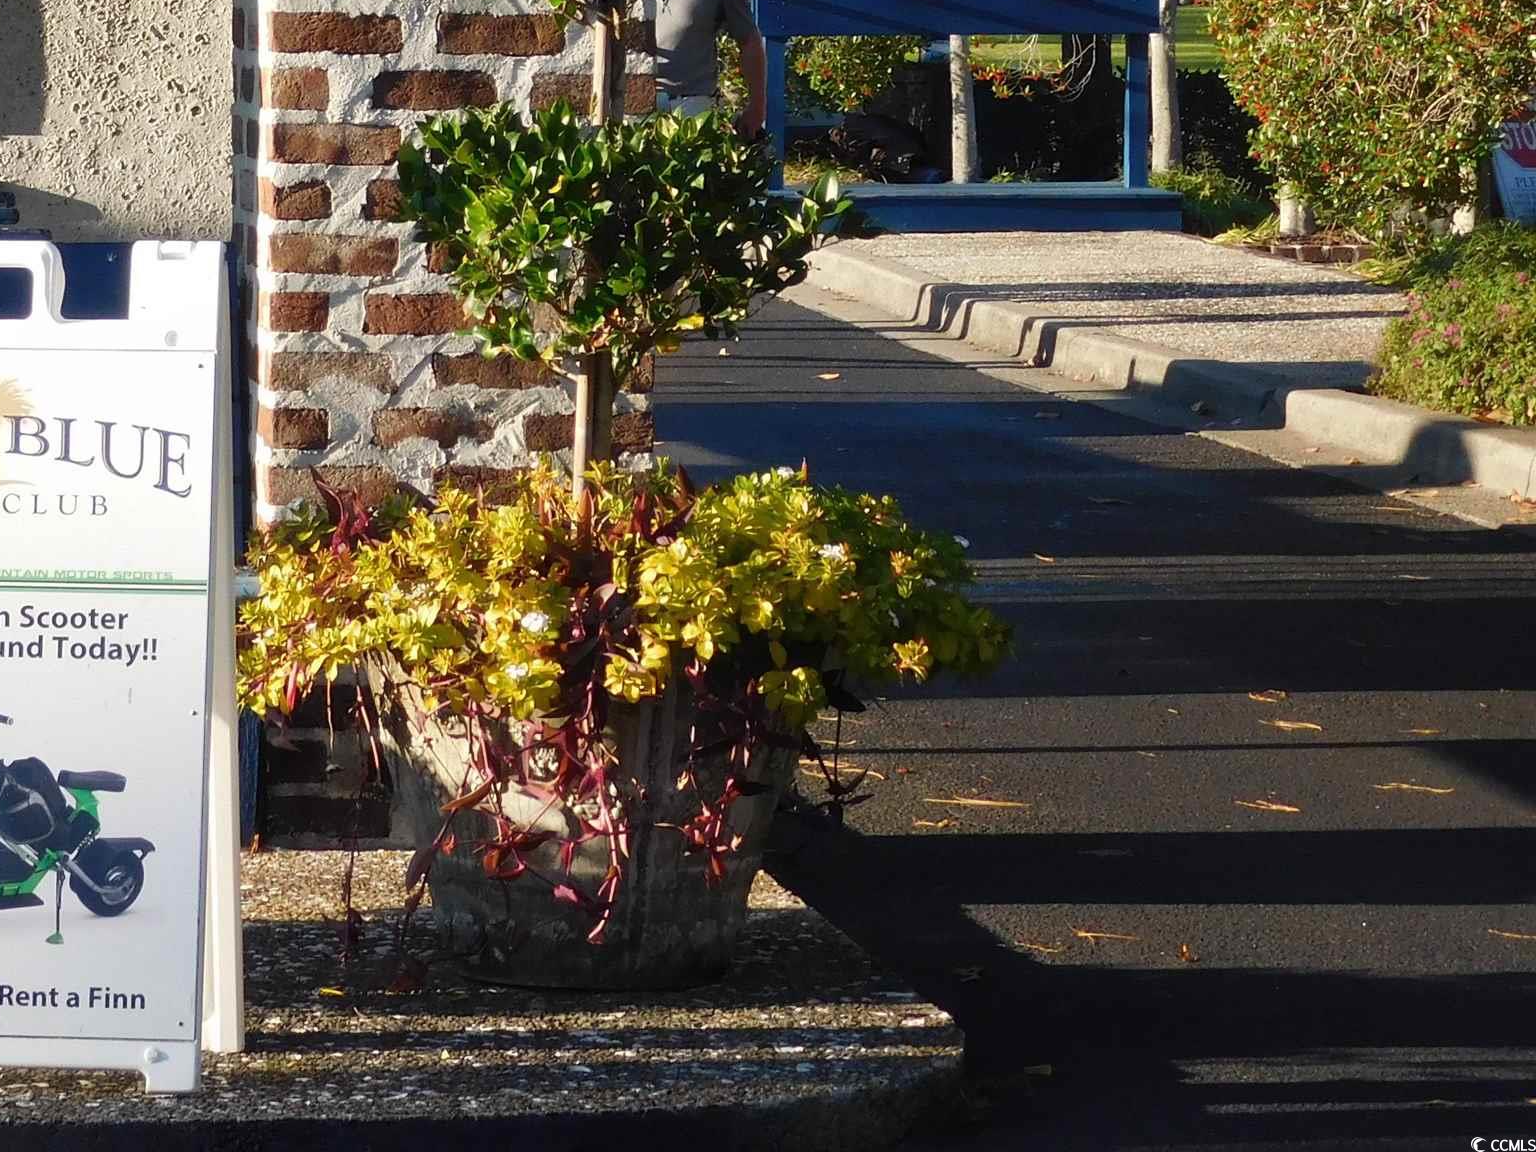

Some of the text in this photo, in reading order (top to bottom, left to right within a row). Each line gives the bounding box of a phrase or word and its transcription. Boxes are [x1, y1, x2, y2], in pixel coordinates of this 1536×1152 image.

[4, 415, 192, 499] BLUE
[2, 493, 109, 516] CLUB
[54, 569, 107, 580] MOTOR
[113, 570, 174, 581] SPORTS
[19, 605, 129, 630] Scooter
[52, 635, 158, 668] Today!!
[66, 991, 80, 1009] a
[88, 986, 146, 1010] Finn
